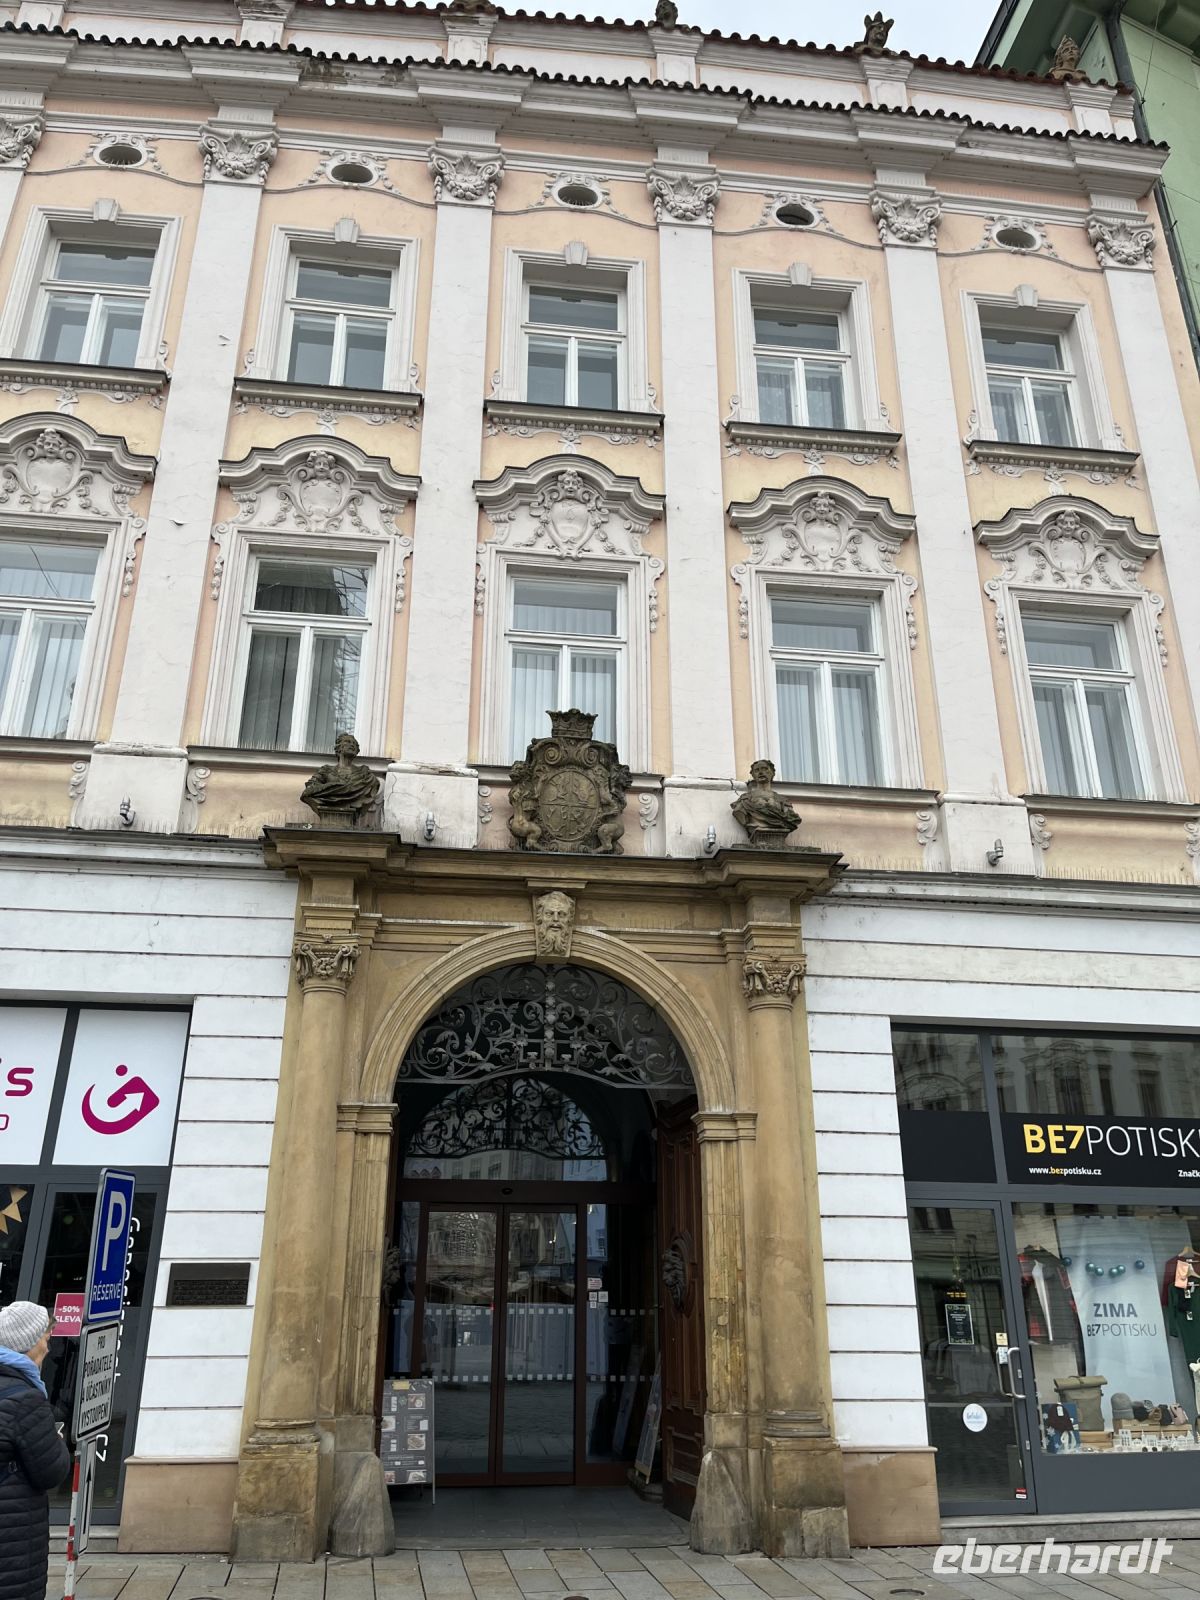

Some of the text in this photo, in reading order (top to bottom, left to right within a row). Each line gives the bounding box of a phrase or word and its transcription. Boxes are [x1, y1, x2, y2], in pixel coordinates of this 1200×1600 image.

[1029, 1167, 1102, 1177] www.bezpotisku.cz
[102, 1191, 126, 1271] P
[59, 1305, 79, 1313] -50%
[1093, 1303, 1138, 1318] ZIMA
[55, 1315, 80, 1323] SLEVA
[97, 1335, 105, 1350] PRO
